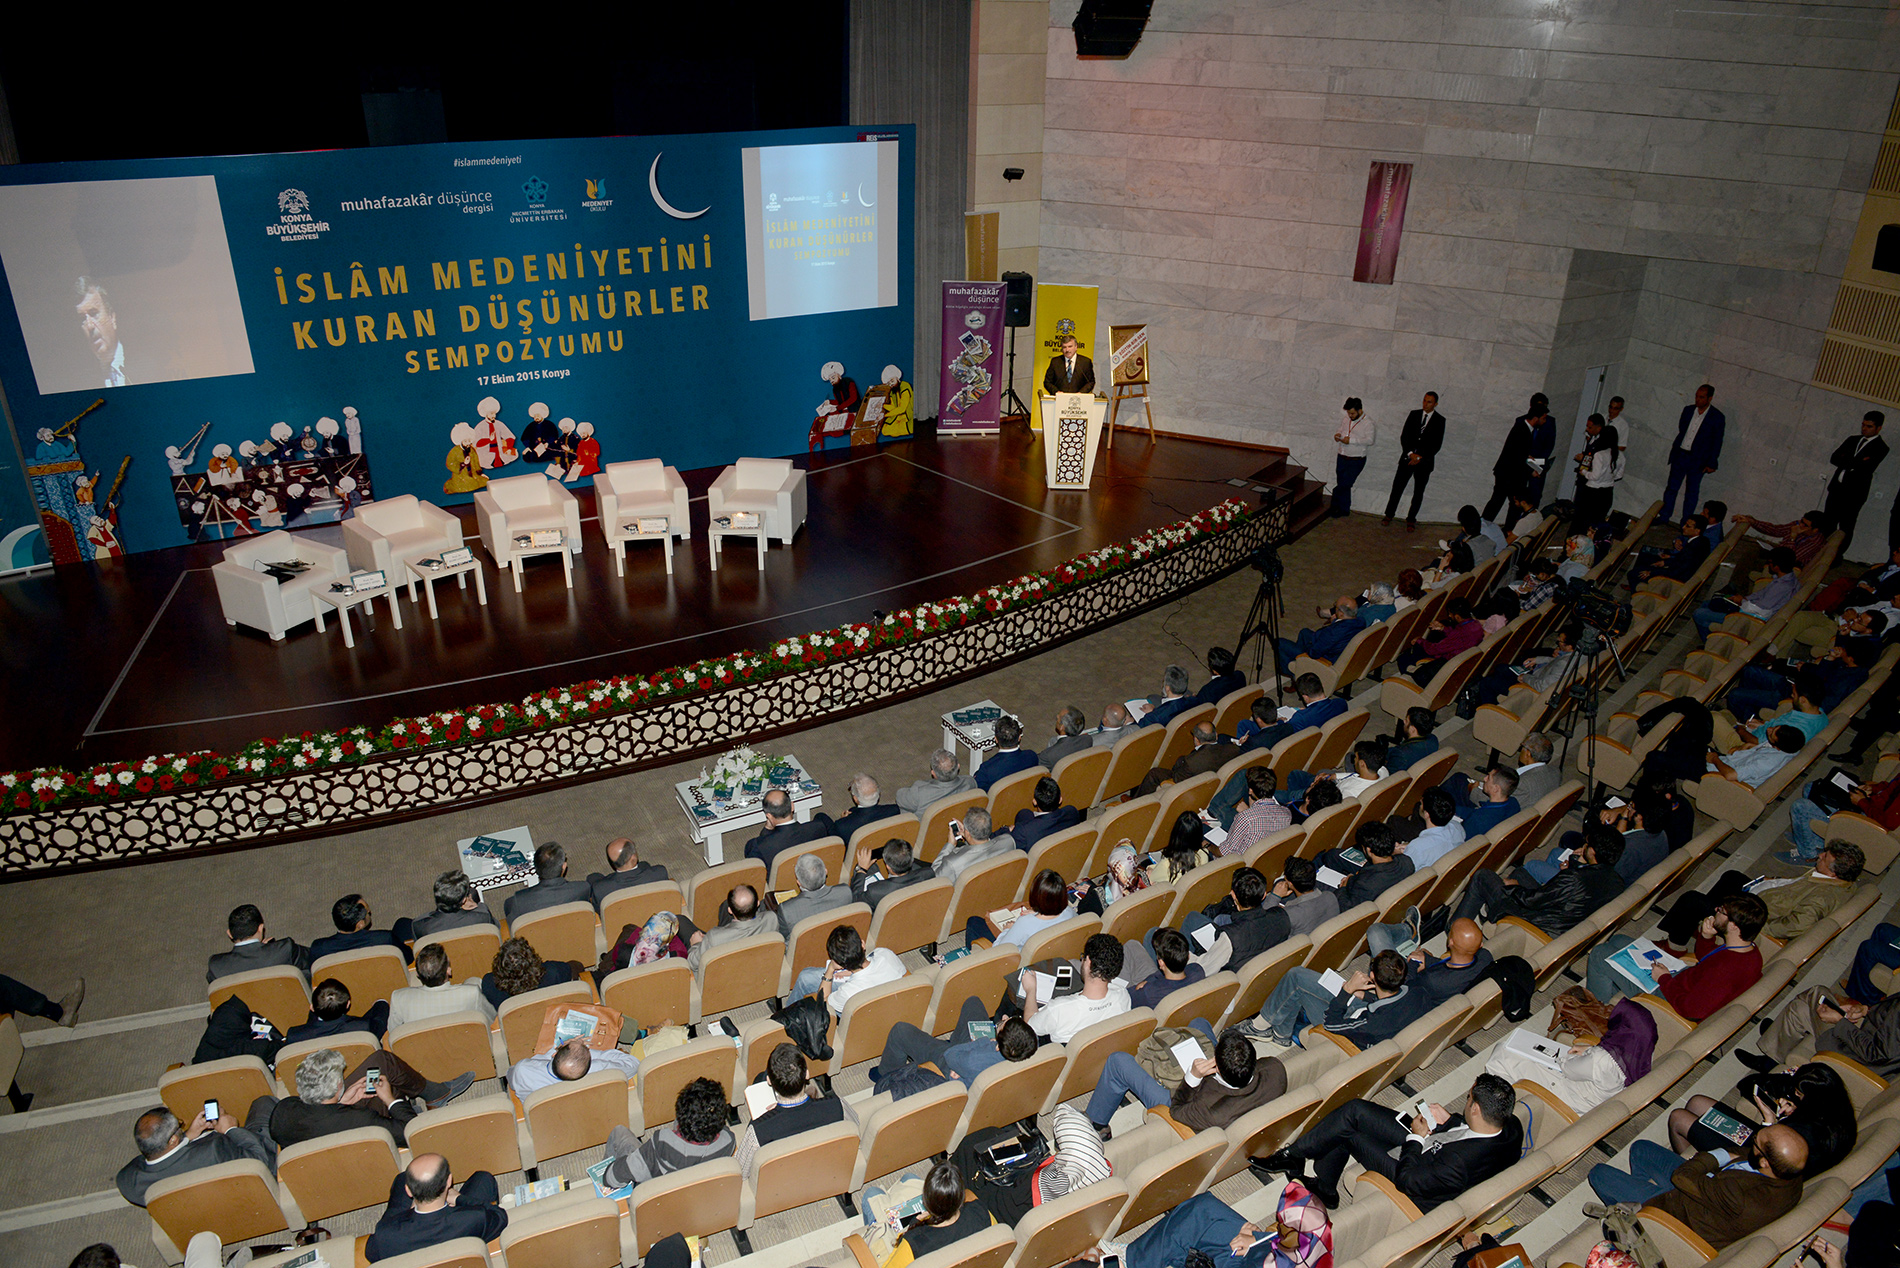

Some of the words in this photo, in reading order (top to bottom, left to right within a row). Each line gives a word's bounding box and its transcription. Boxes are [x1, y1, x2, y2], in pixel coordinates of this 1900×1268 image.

[453, 155, 522, 167] #islammedeniyeti
[341, 192, 433, 211] muhafazakâr
[437, 191, 492, 206] düşünce
[462, 203, 494, 214] dergisi
[280, 213, 313, 223] KONYA
[509, 213, 568, 223] ÜNİVERSİTESİ
[766, 217, 798, 233] İSLÂM
[803, 212, 875, 231] MEDENİYETİNİ
[266, 220, 330, 235] BÜYÜKŞEHİR
[281, 233, 319, 242] BELEDİYESİ
[769, 236, 803, 249] KURAN
[808, 230, 874, 248] DÜŞÜNÜRLER
[794, 247, 850, 260] SEMPOZYUMU
[274, 261, 408, 304] İSLÂM
[431, 233, 712, 291] MEDENİYETİNİ
[949, 287, 1000, 295] muhafazakâr
[968, 295, 1000, 304] düşünce
[292, 308, 436, 350] KURAN
[458, 284, 709, 335] DÜŞÜNÜRLER
[405, 330, 624, 374] SEMPOZYUMU
[477, 376, 489, 386] 17
[491, 373, 515, 385] Ekim
[516, 370, 540, 382] 2015
[542, 368, 571, 380] Konya
